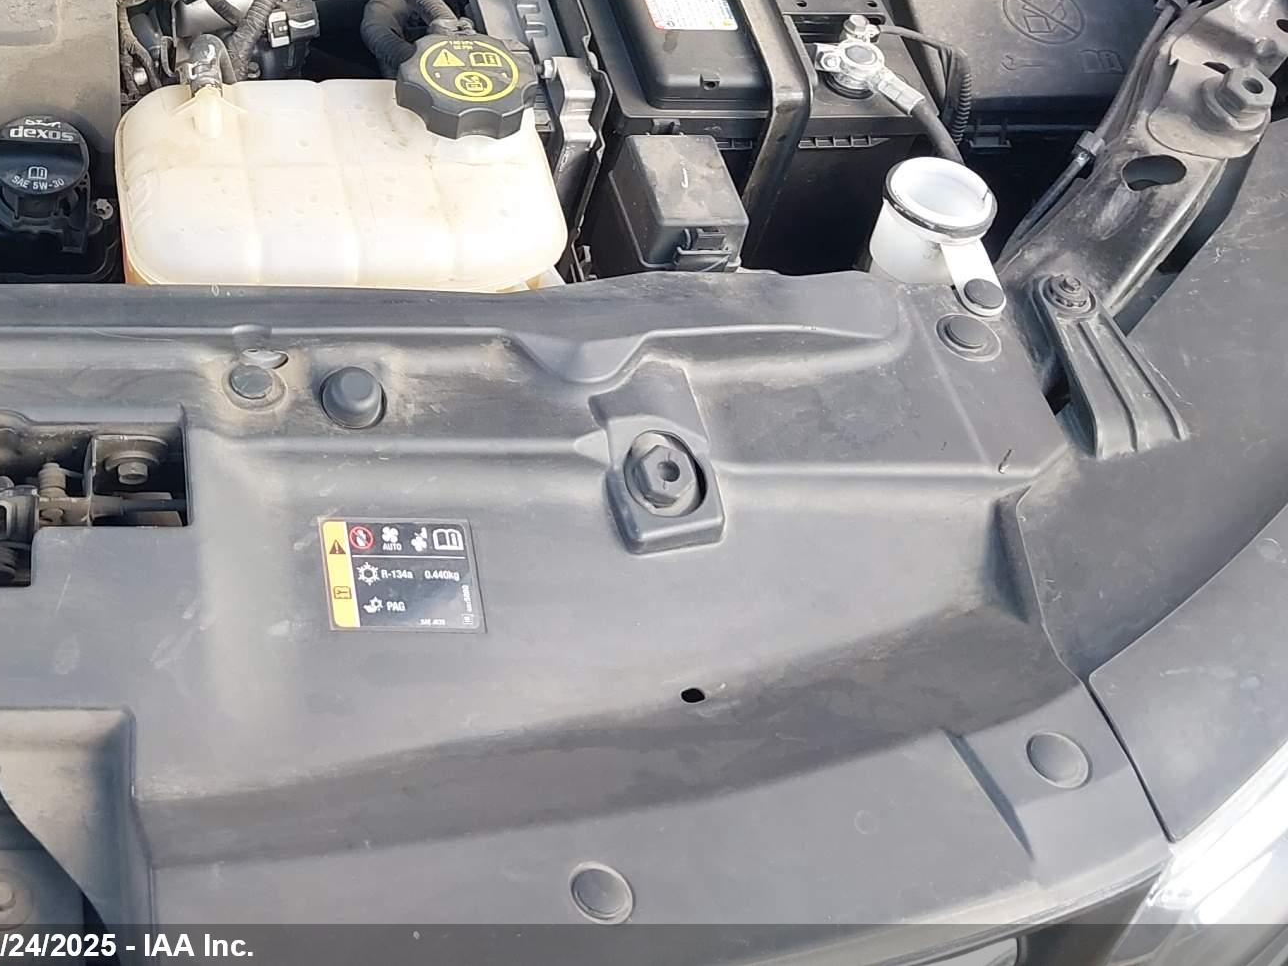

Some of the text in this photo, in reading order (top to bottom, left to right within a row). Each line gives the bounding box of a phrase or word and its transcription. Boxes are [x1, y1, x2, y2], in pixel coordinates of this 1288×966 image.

[9, 125, 77, 142] dexos
[11, 175, 65, 190] SAE 5W-30
[382, 543, 402, 551] AUTO
[381, 570, 460, 582] R-134a 0.440kg
[386, 601, 406, 612] PAG
